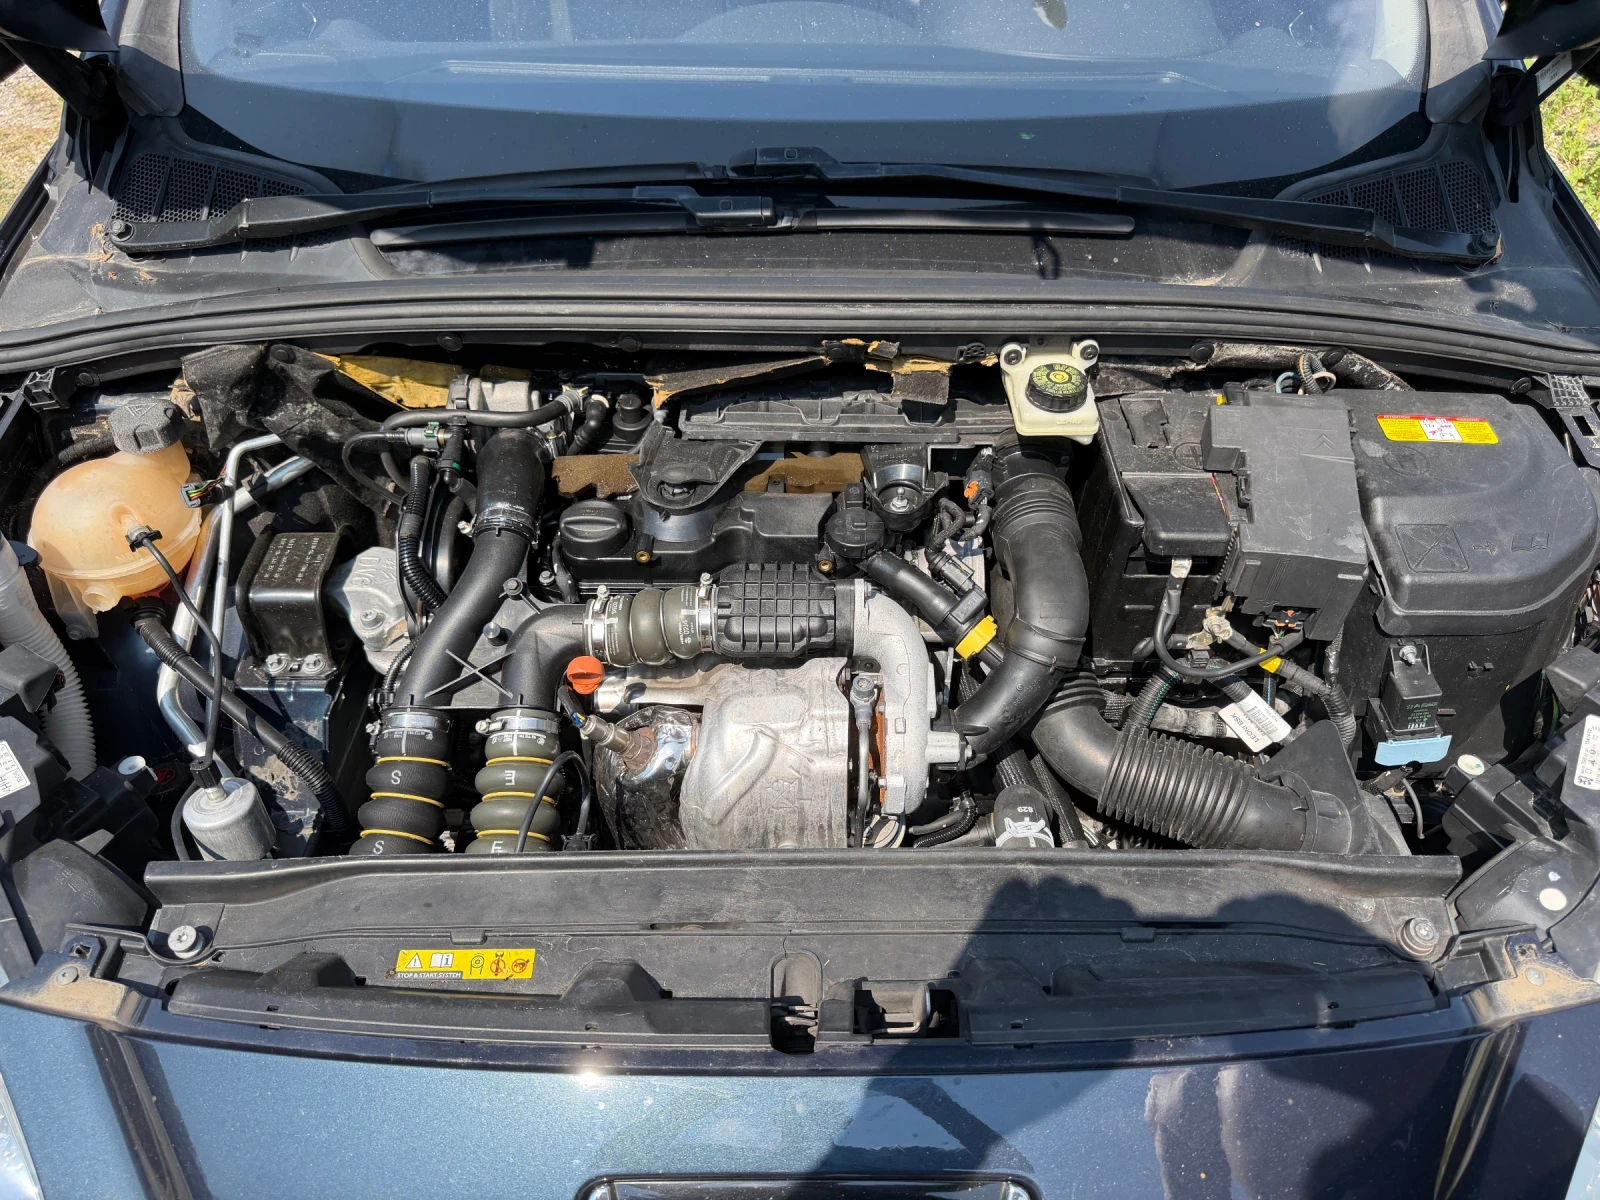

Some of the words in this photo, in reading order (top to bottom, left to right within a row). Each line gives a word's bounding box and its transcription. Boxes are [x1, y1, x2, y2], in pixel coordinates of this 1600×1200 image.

[1242, 725, 1260, 743] LEONI
[392, 770, 402, 785] S
[373, 840, 384, 854] S
